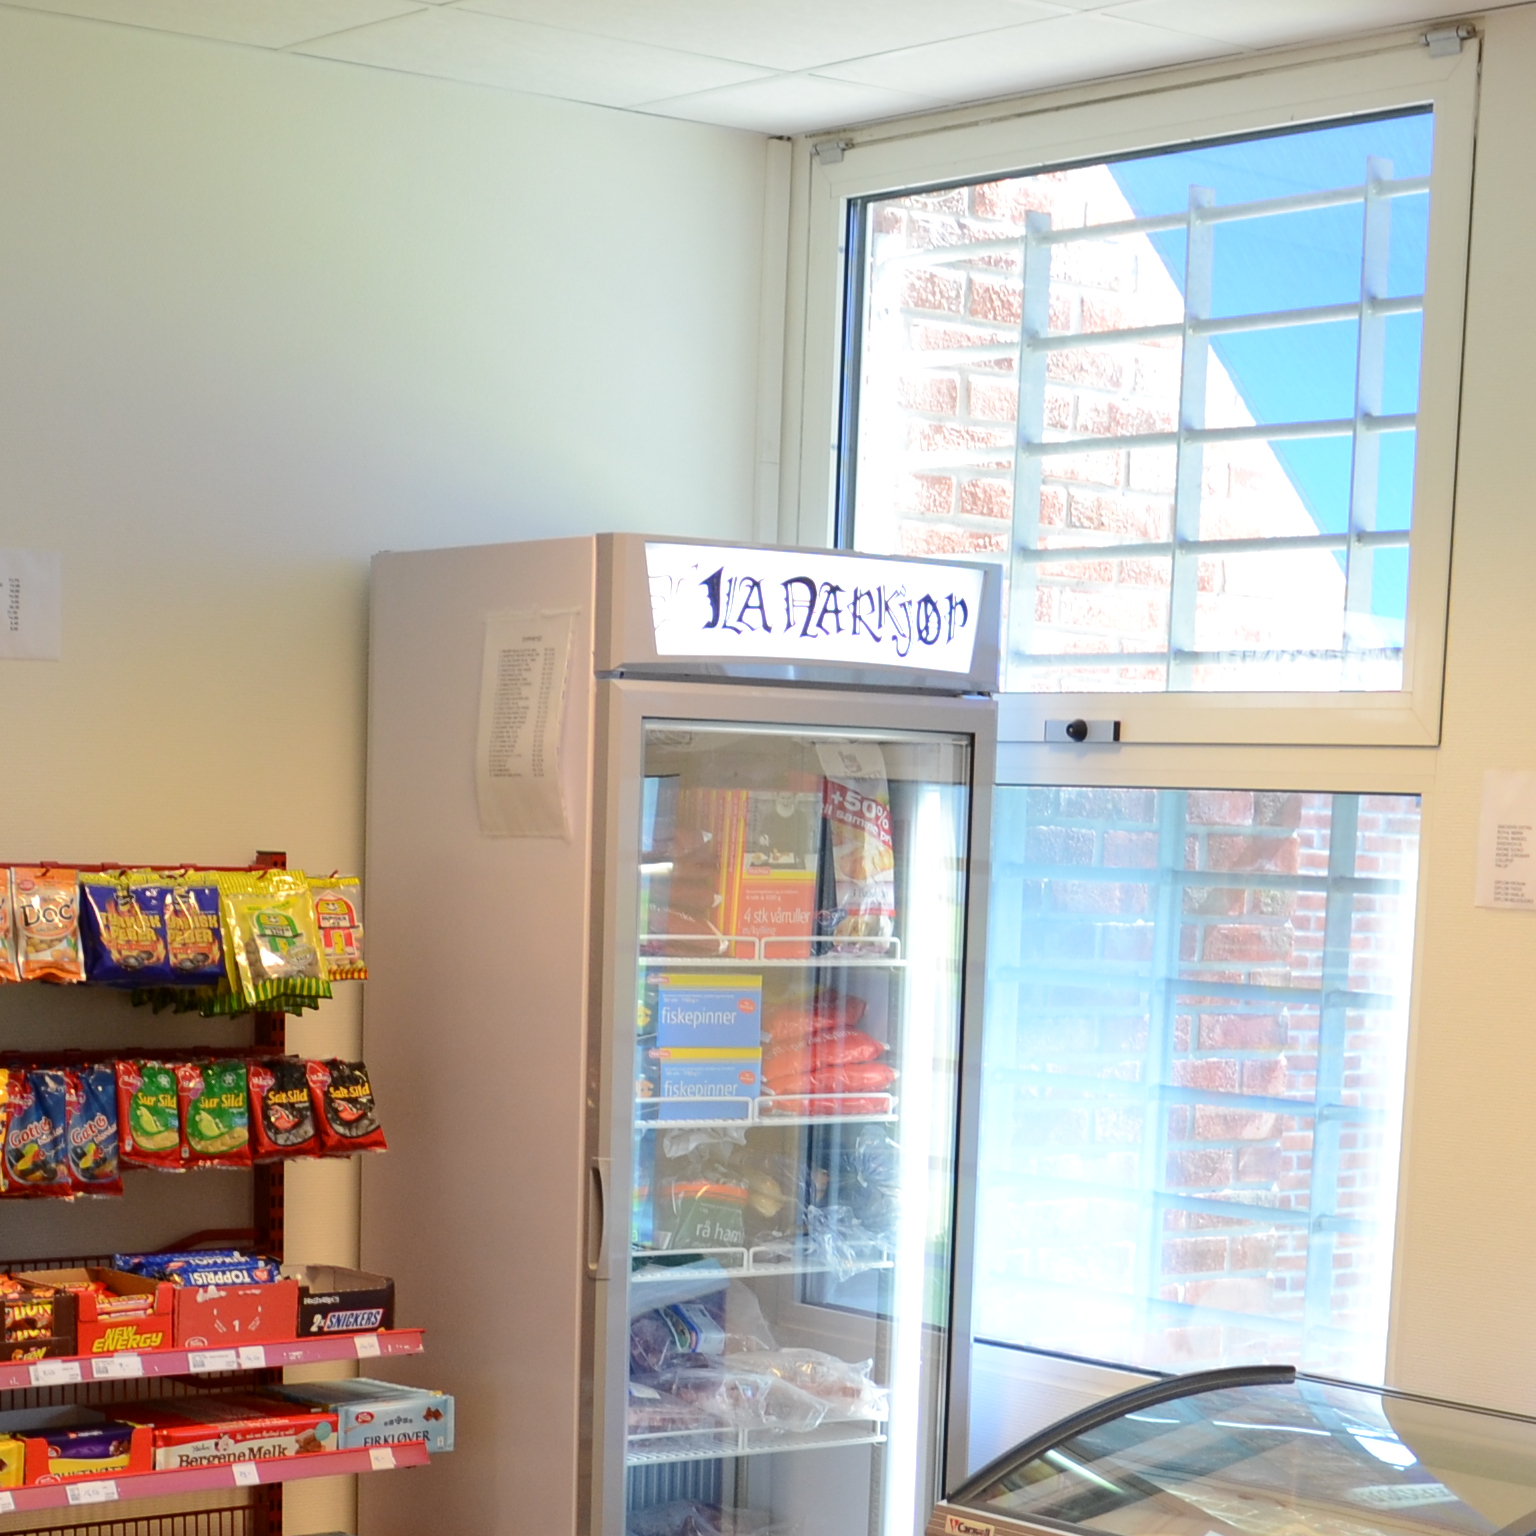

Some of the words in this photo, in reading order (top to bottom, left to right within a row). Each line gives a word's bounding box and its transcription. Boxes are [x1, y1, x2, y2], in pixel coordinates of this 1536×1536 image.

[831, 791, 890, 829] +50%
[836, 809, 879, 834] samme
[744, 908, 751, 923] 4
[753, 908, 768, 923] stk
[770, 908, 811, 925] vårruller
[661, 1007, 737, 1028] fiskepinner
[286, 1088, 308, 1102] Sild
[350, 1083, 370, 1098] Sild
[663, 1080, 738, 1097] fiskepinner
[137, 1091, 156, 1106] Sur
[158, 1092, 177, 1108] Sild
[221, 1093, 243, 1107] Sild
[696, 1220, 711, 1237] rå
[326, 1309, 382, 1330] SNICKERS
[105, 1325, 137, 1340] NEW
[92, 1331, 163, 1353] ENERGY
[363, 1430, 430, 1447] FIRKLØVER
[178, 1448, 245, 1468] Bergene
[247, 1445, 288, 1461] Melk
